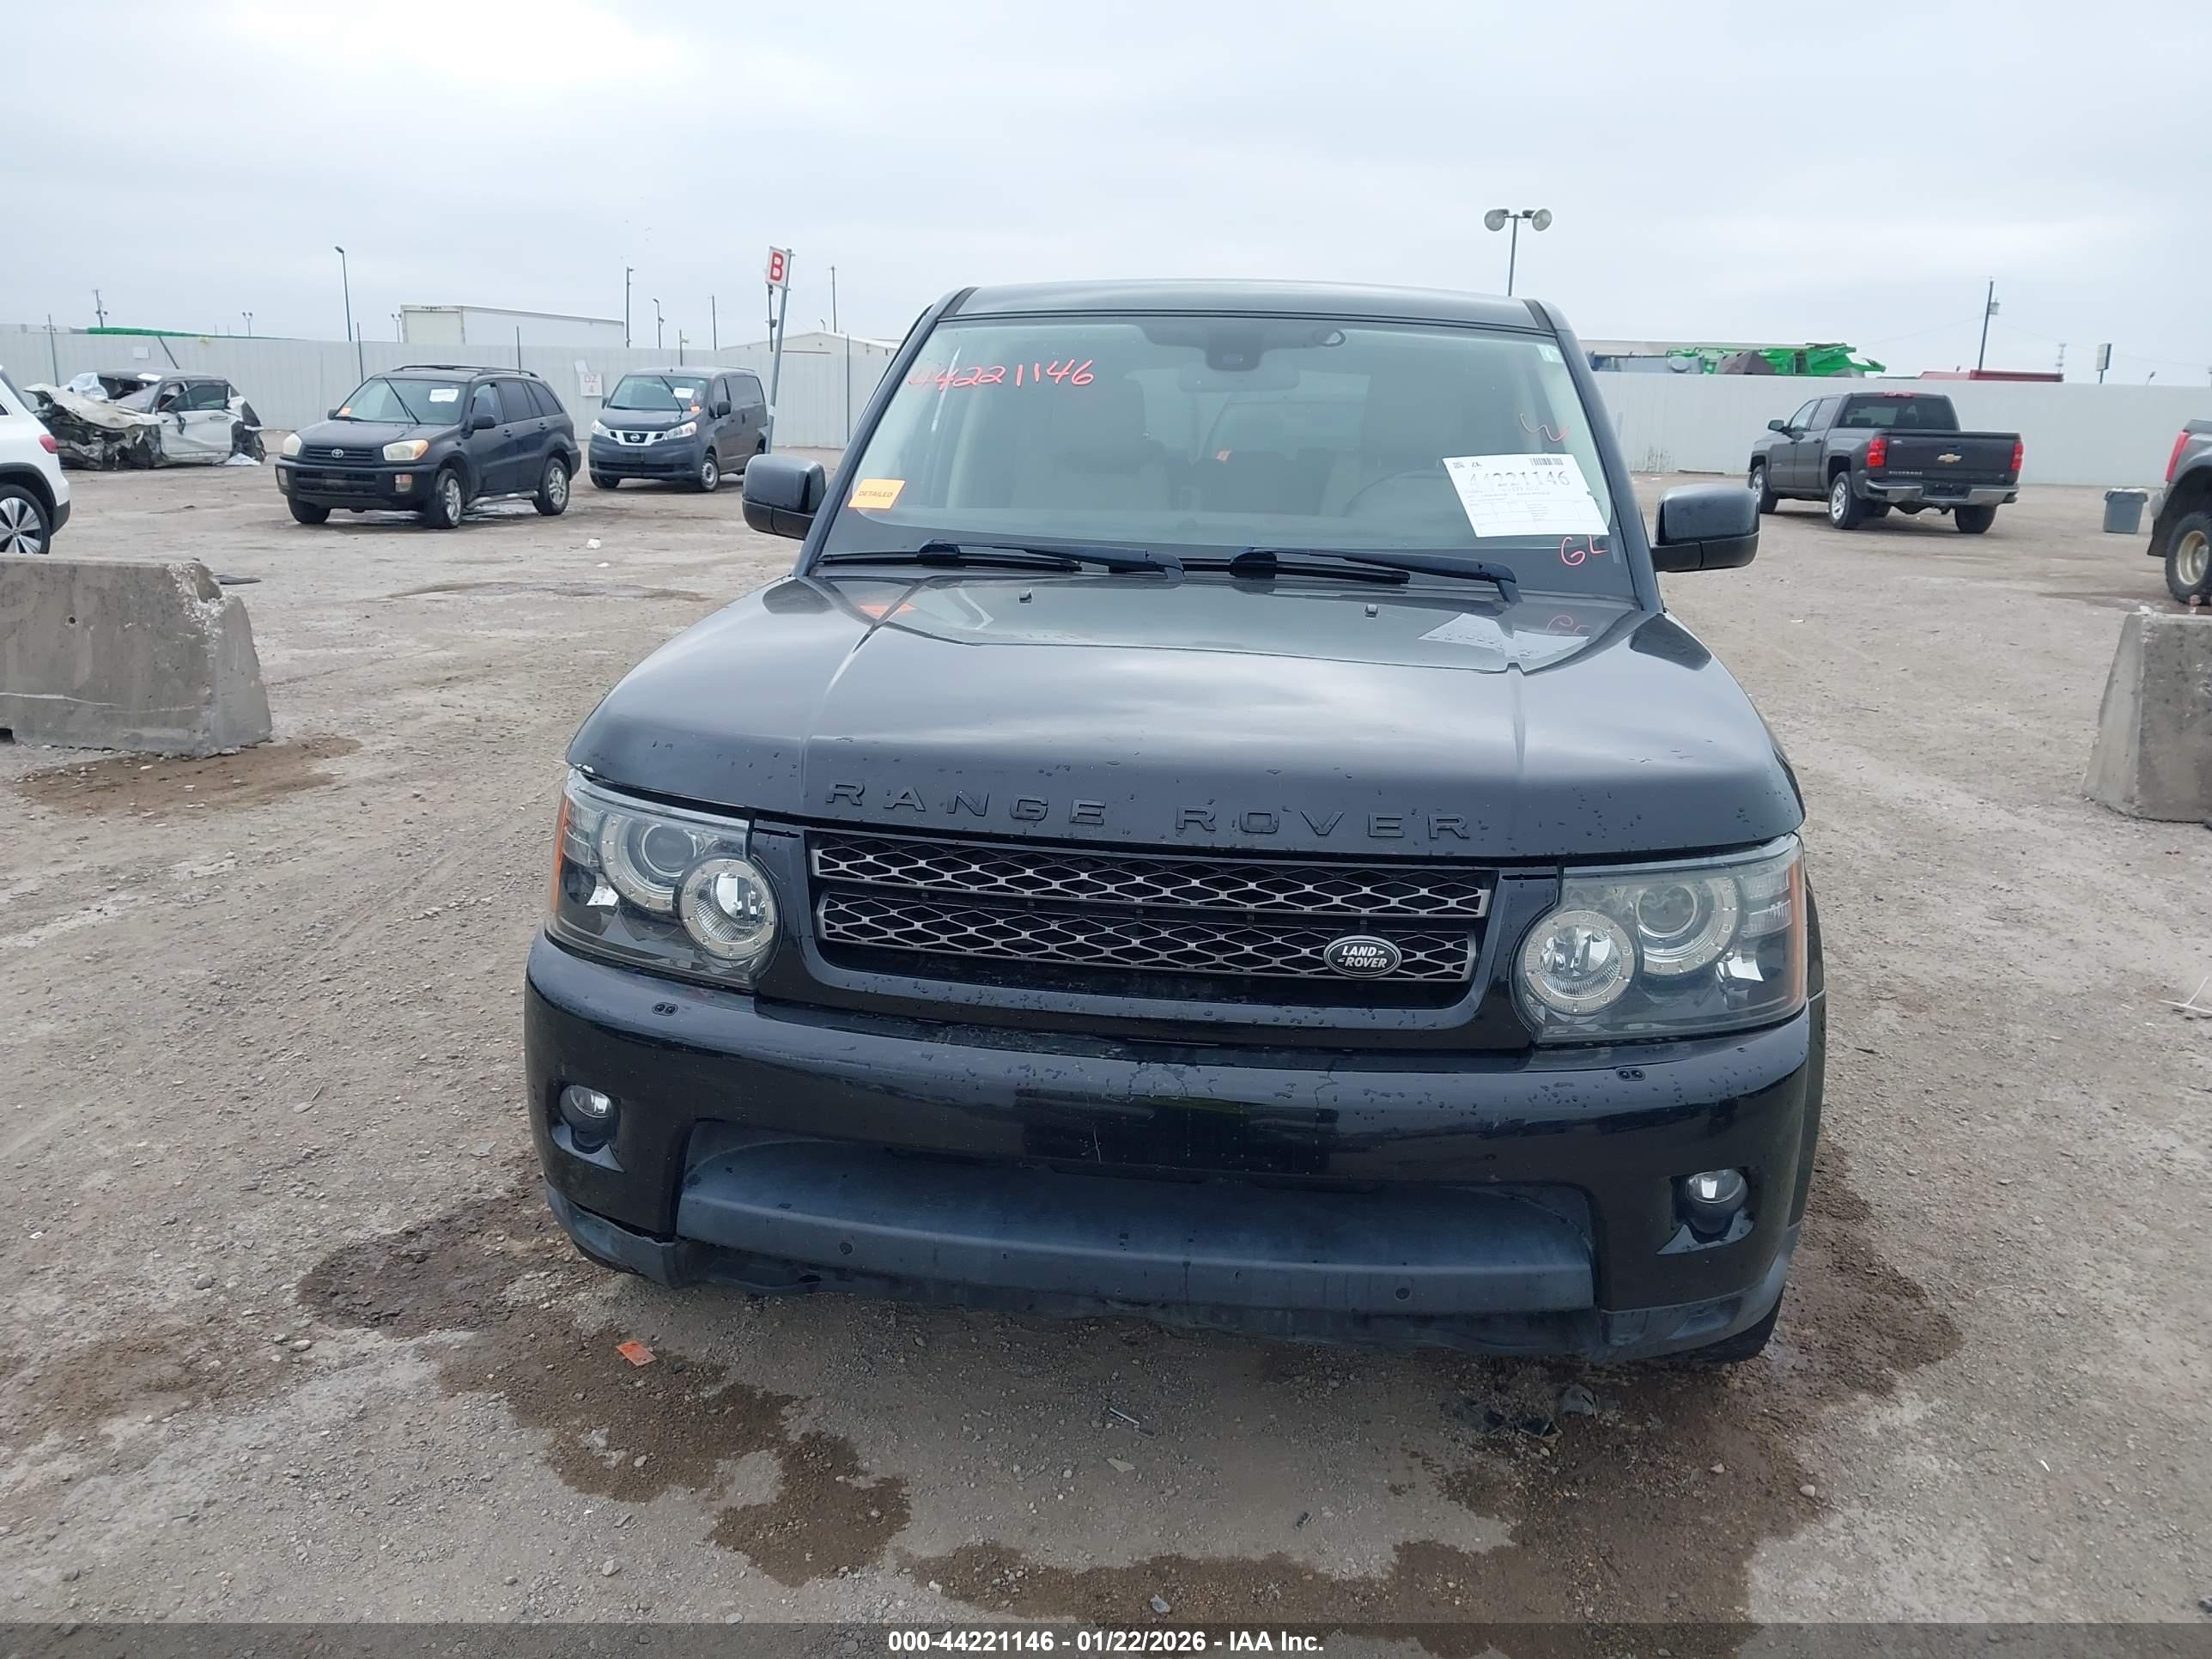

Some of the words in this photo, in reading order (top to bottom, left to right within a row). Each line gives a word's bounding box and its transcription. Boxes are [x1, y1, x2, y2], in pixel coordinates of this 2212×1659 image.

[769, 252, 783, 281] B
[908, 359, 1094, 391] 44221146
[825, 781, 1107, 825] RANGE
[1175, 805, 1470, 839] ROVER
